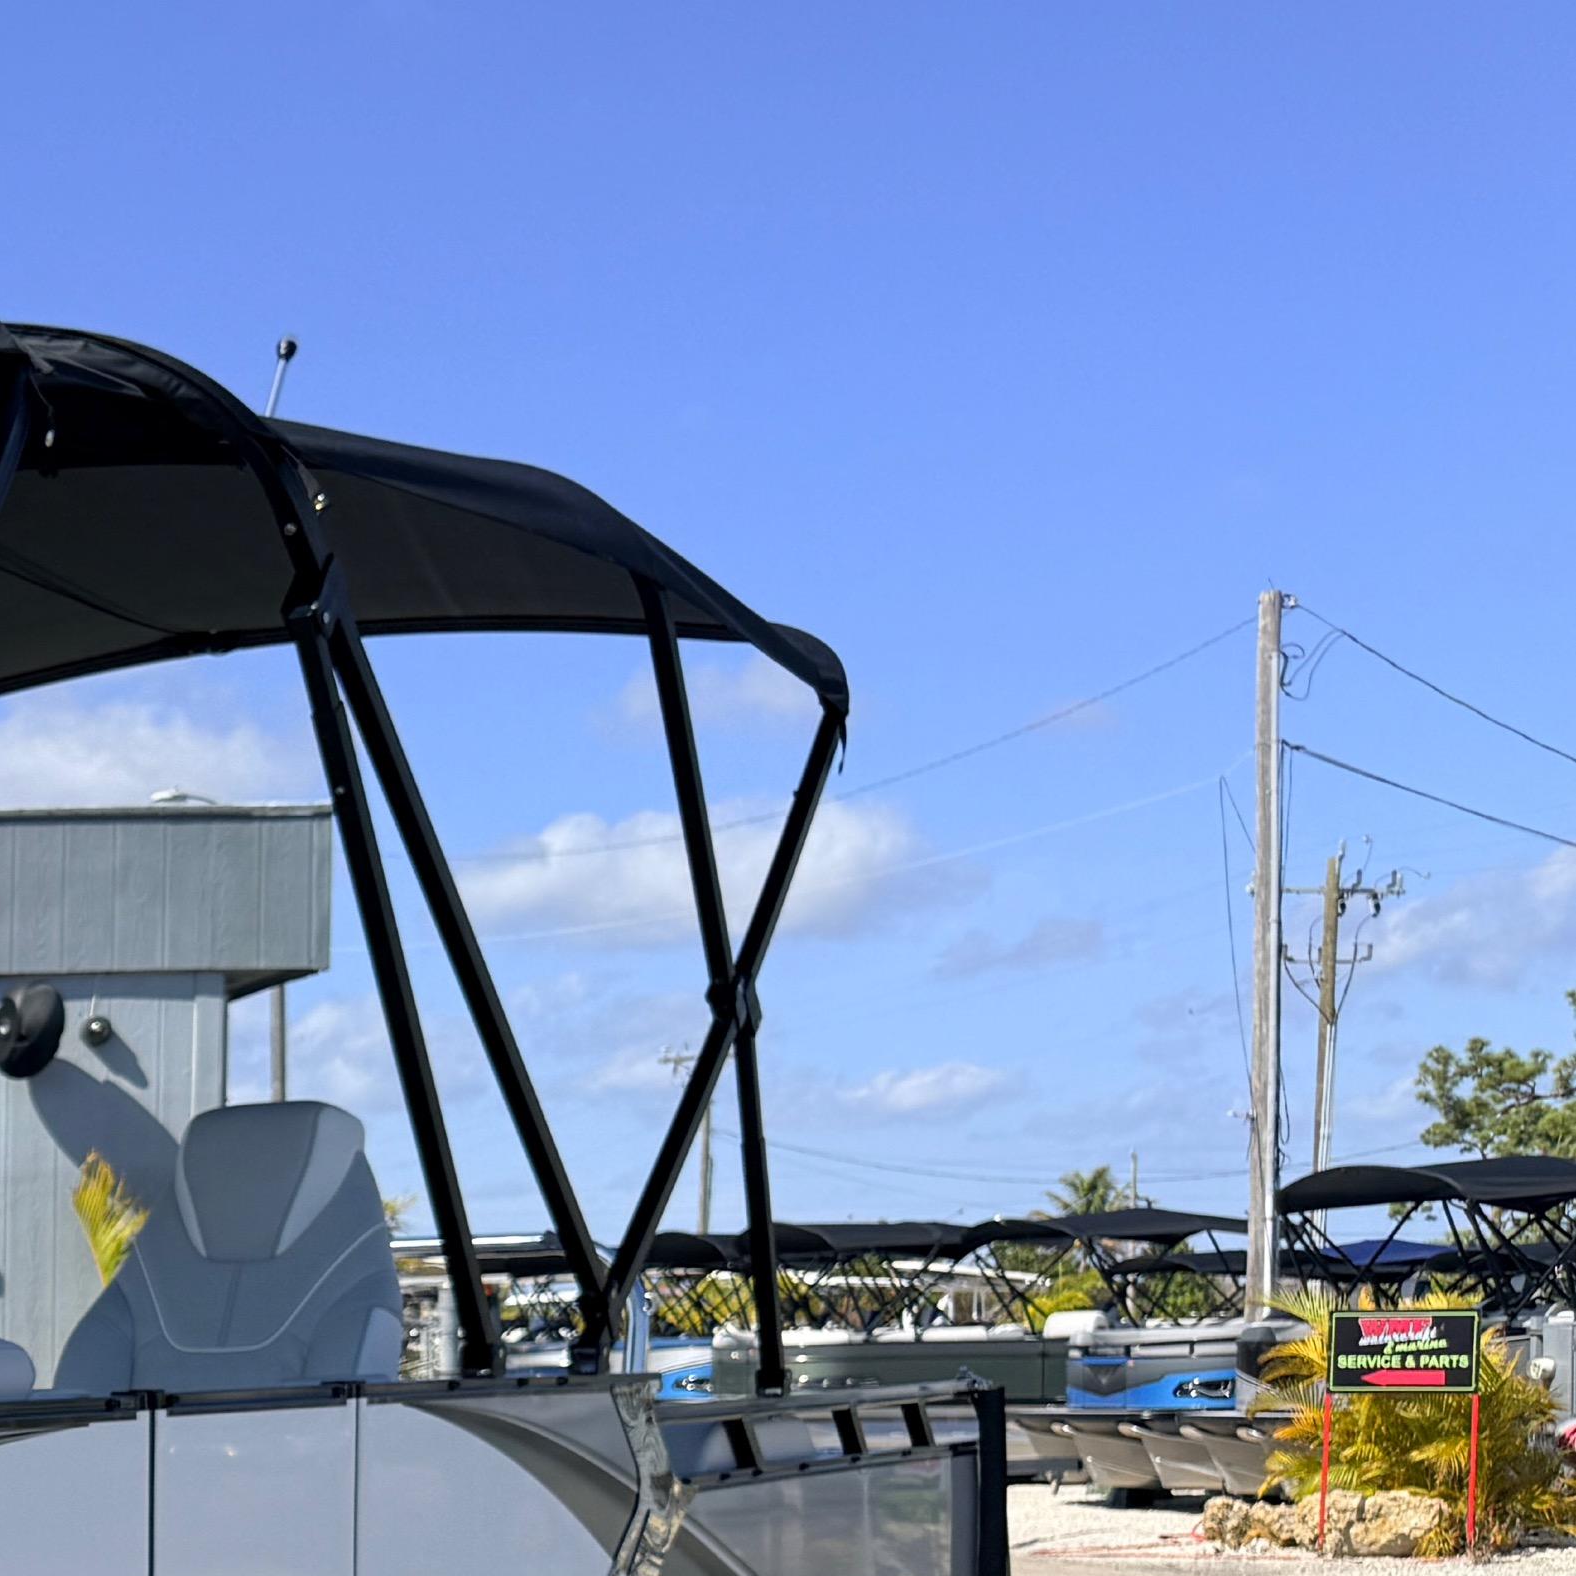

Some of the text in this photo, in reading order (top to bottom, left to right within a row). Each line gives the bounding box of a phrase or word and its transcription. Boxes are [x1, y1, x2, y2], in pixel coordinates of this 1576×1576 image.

[1337, 1354, 1469, 1369] SERVICE & PARTS
